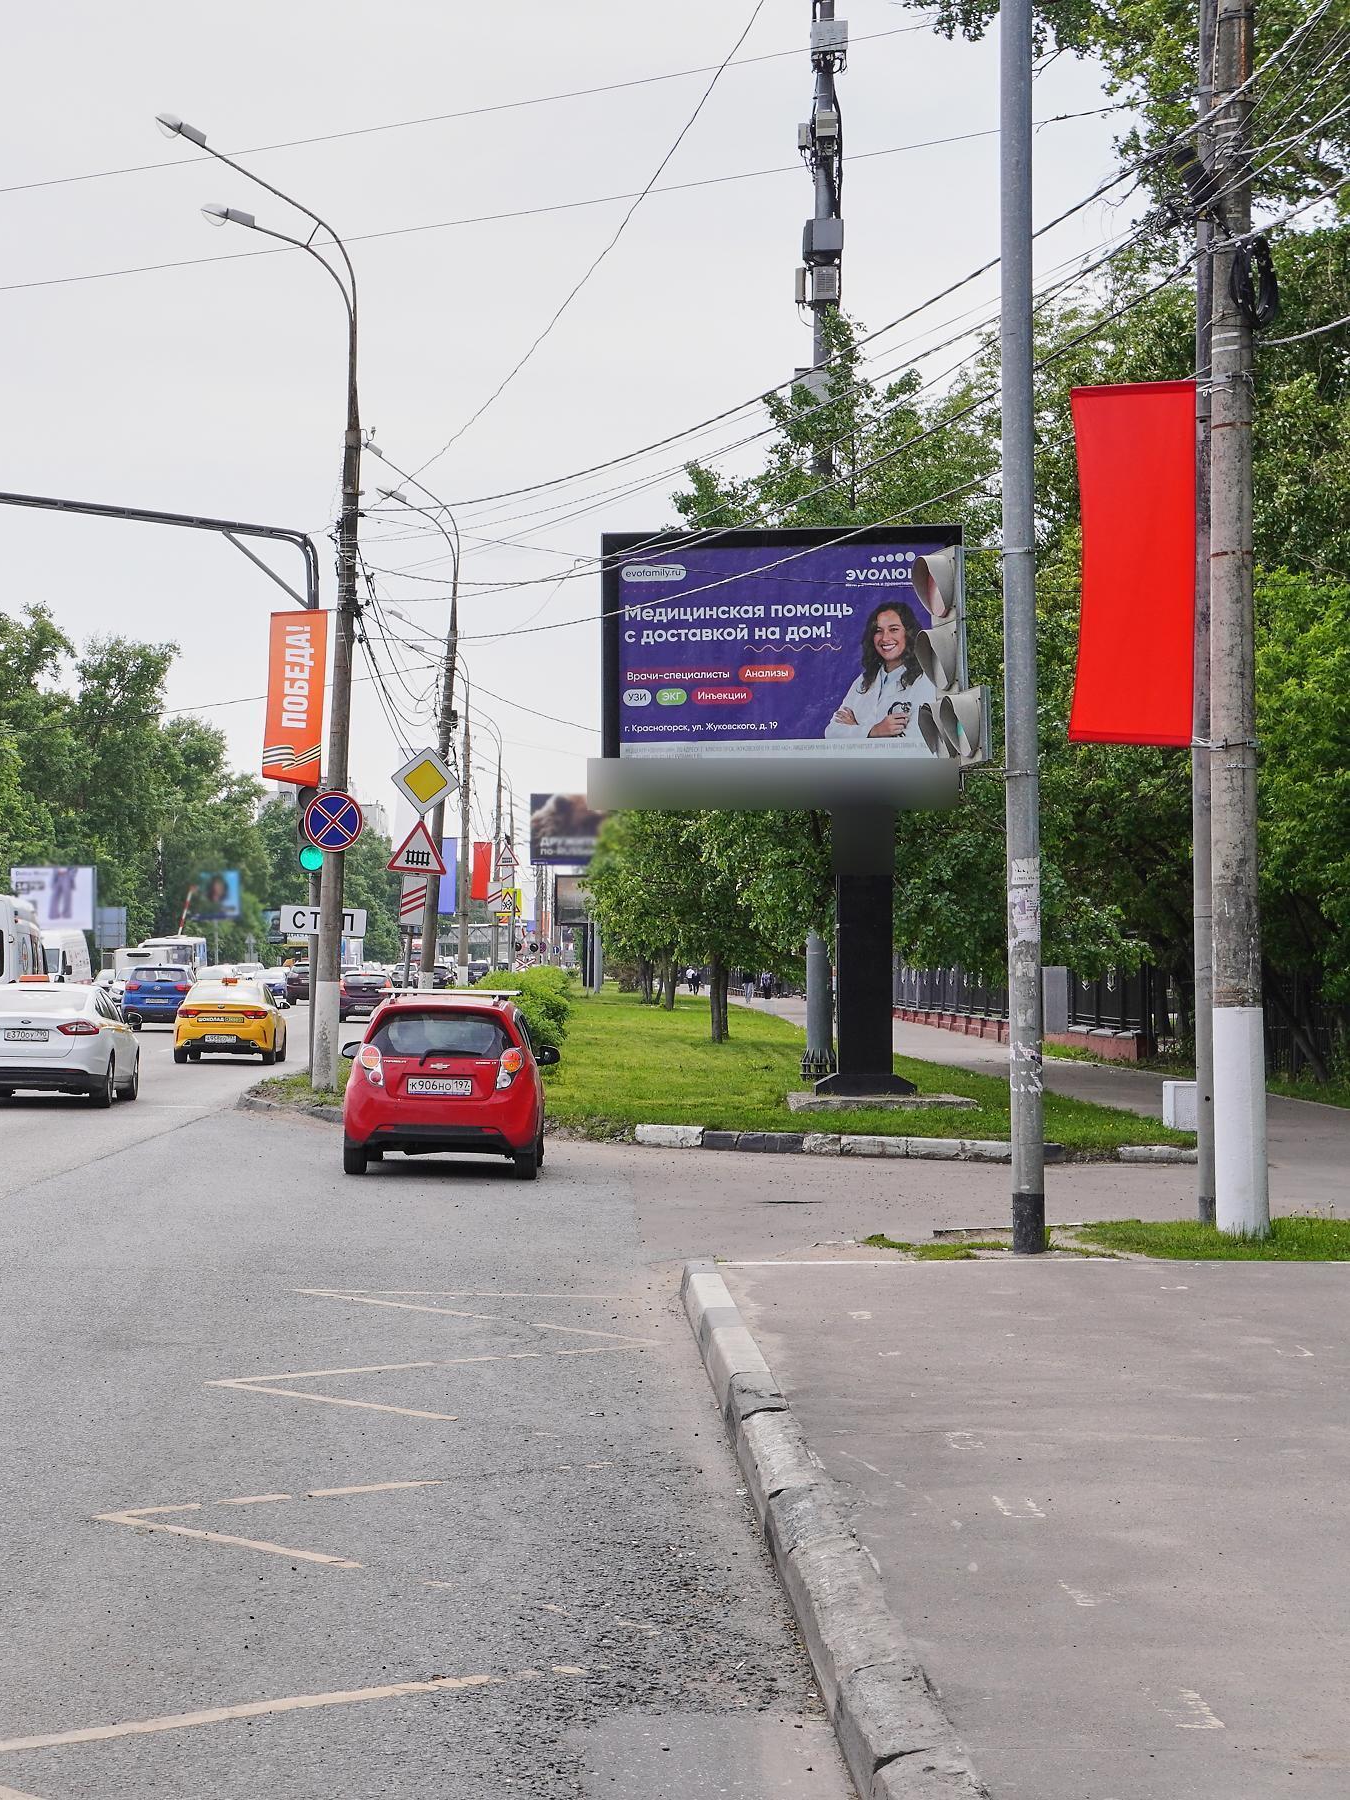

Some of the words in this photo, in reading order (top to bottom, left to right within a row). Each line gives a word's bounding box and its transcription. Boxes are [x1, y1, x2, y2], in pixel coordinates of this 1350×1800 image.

[625, 568, 681, 578] evofamily.ru
[624, 604, 765, 623] Медицинская
[770, 602, 854, 618] помощь
[624, 630, 636, 642] с
[640, 624, 749, 645] доставкой
[754, 626, 780, 640] на
[785, 621, 832, 642] дом!
[281, 625, 315, 729] ПОБЕДА!
[626, 671, 730, 681] Врачи-специалисты
[744, 668, 789, 679] Анализы
[628, 693, 647, 702] УЗИ
[662, 692, 682, 701] ЭКГ
[697, 691, 747, 701] Инъекции
[631, 724, 690, 733] Красногорск,
[692, 723, 704, 732] ул.
[705, 722, 758, 731] Жуковского,
[769, 721, 778, 730] 19
[292, 910, 355, 932] СТП
